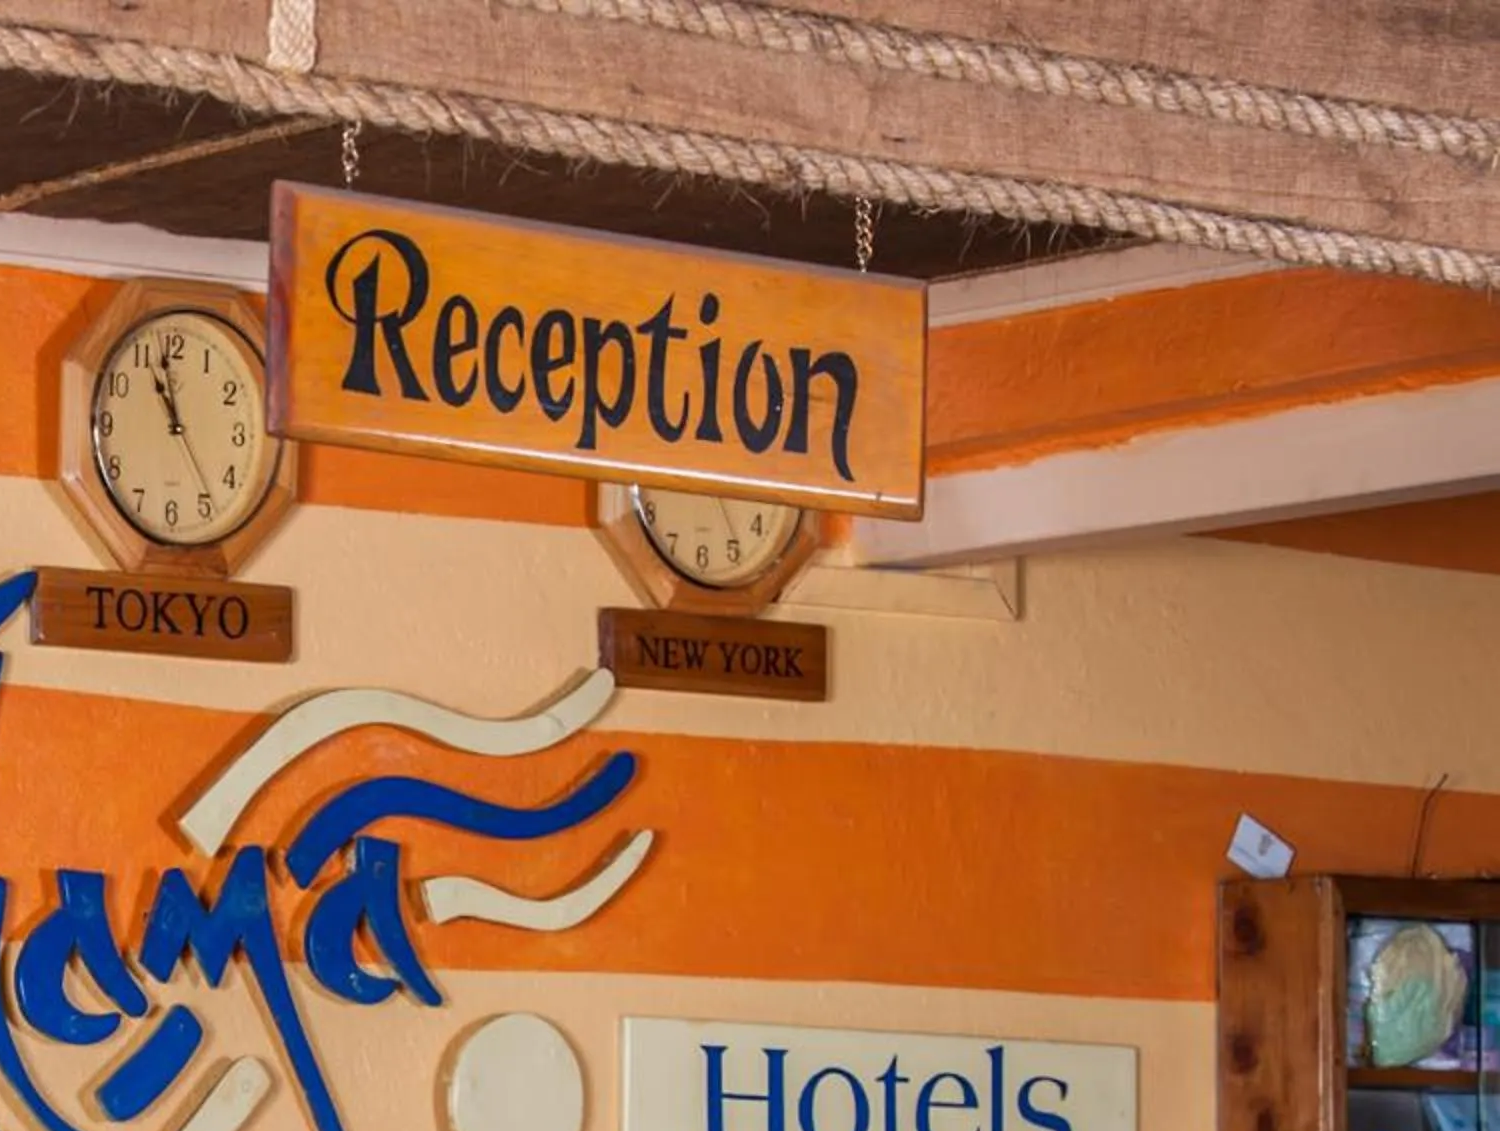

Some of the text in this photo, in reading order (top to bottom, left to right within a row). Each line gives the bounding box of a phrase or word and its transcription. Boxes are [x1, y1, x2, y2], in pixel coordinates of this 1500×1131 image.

[134, 344, 150, 368] 11
[165, 334, 185, 360] 12
[325, 229, 859, 482] Reception
[203, 350, 210, 374] 1
[108, 372, 129, 398] 10
[224, 381, 237, 405] 2
[101, 410, 113, 437] 9
[232, 424, 245, 447] 3
[109, 456, 121, 481] 8
[223, 465, 236, 489] 4
[132, 488, 145, 513] 7
[197, 494, 211, 519] 5
[645, 501, 656, 525] 8
[165, 501, 178, 527] 6
[750, 514, 762, 537] 4
[666, 533, 678, 558] 7
[696, 545, 709, 569] 6
[727, 540, 740, 562] 5
[87, 586, 249, 640] TOKYO
[636, 635, 804, 678] NEW YORK
